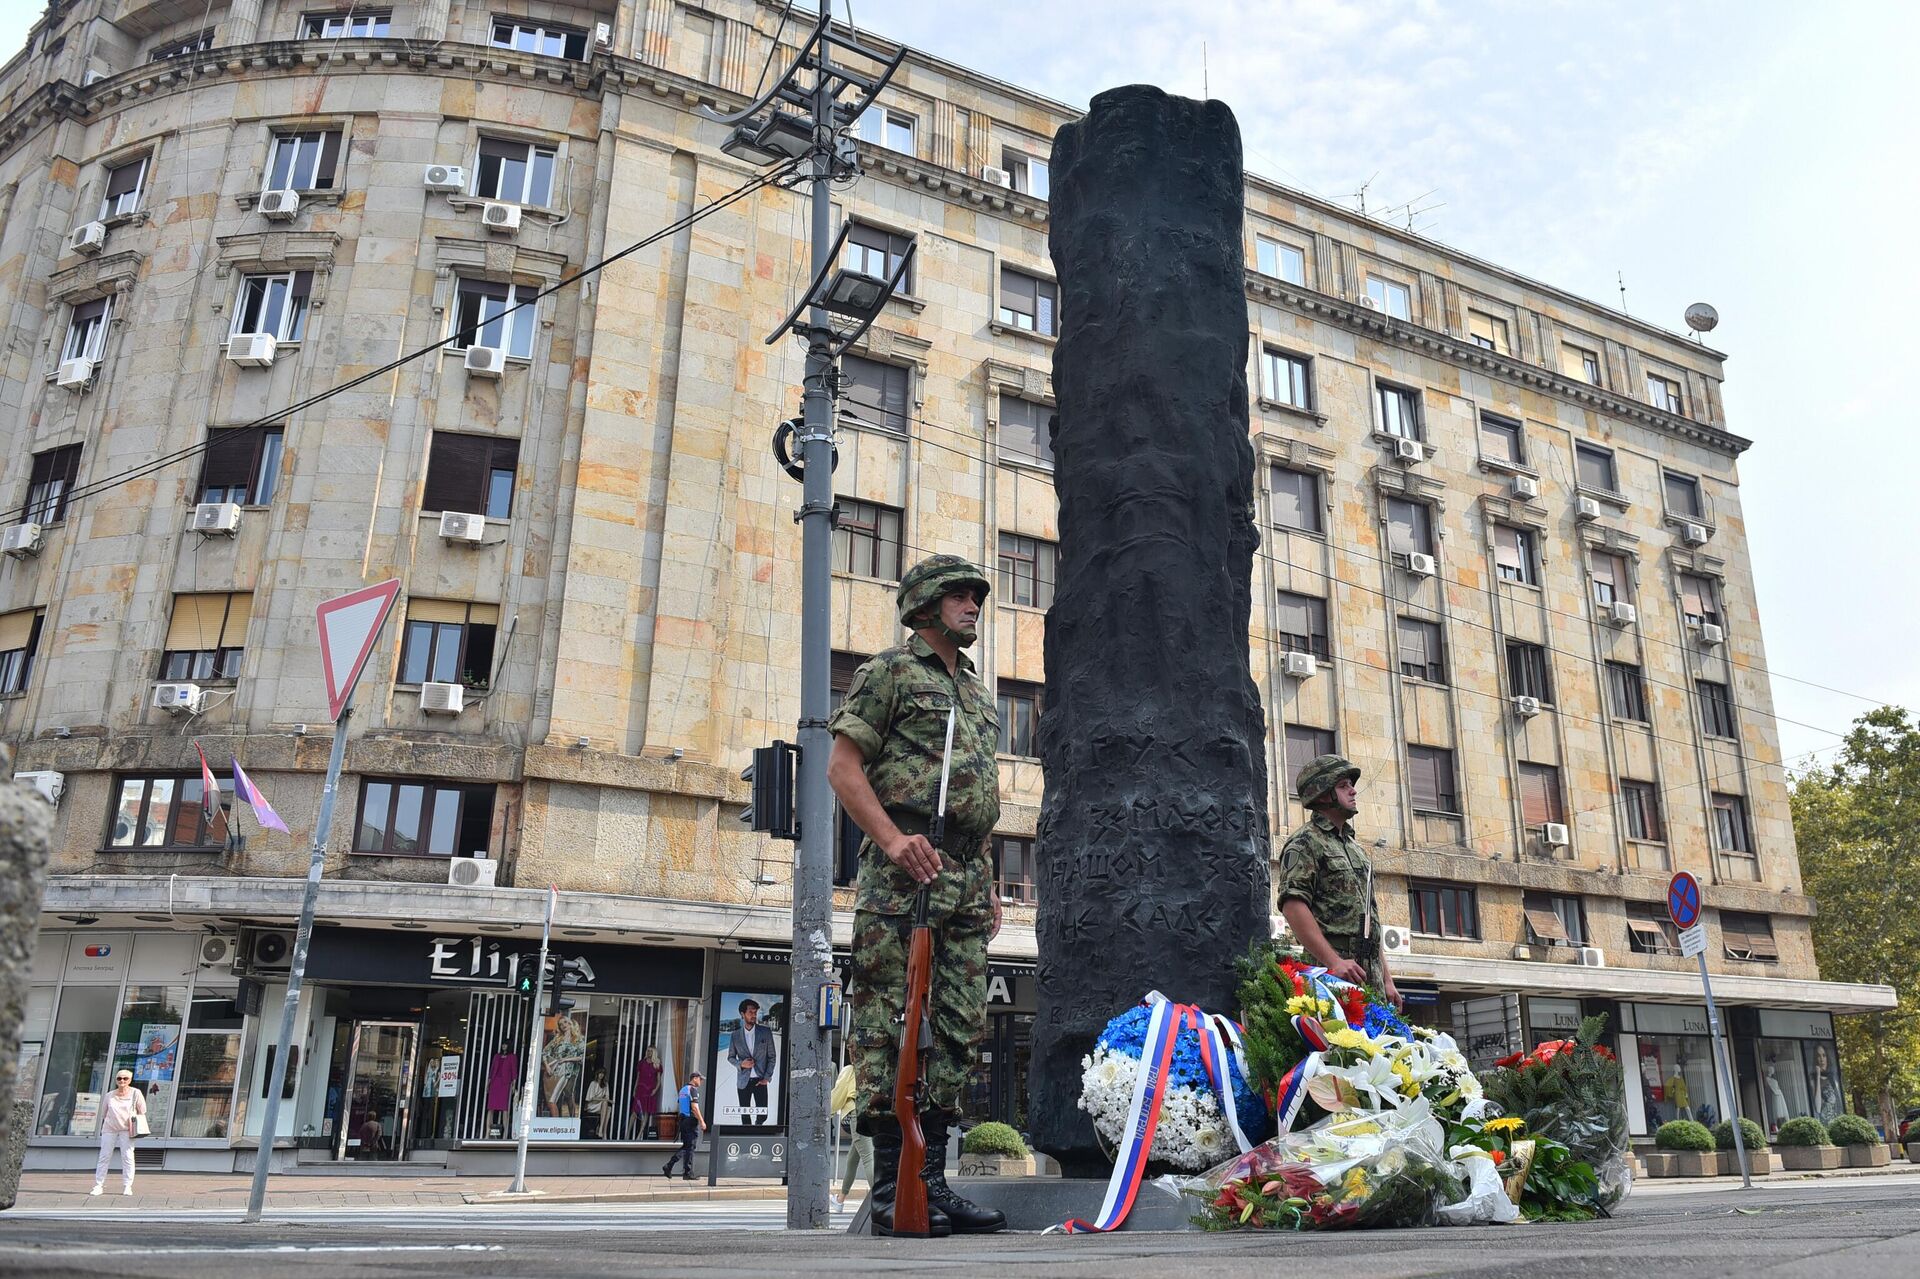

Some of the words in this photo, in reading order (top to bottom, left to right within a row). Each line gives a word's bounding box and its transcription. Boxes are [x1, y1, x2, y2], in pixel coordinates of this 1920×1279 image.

[427, 935, 596, 988] Elia
[1553, 1013, 1580, 1026] LUNA
[1682, 1019, 1706, 1032] LUNA
[1810, 1025, 1831, 1036] LUNA
[1146, 1065, 1160, 1089] ГРАД
[1135, 1096, 1153, 1140] БЕОГРАД
[532, 1126, 576, 1135] www.elipsa.rs
